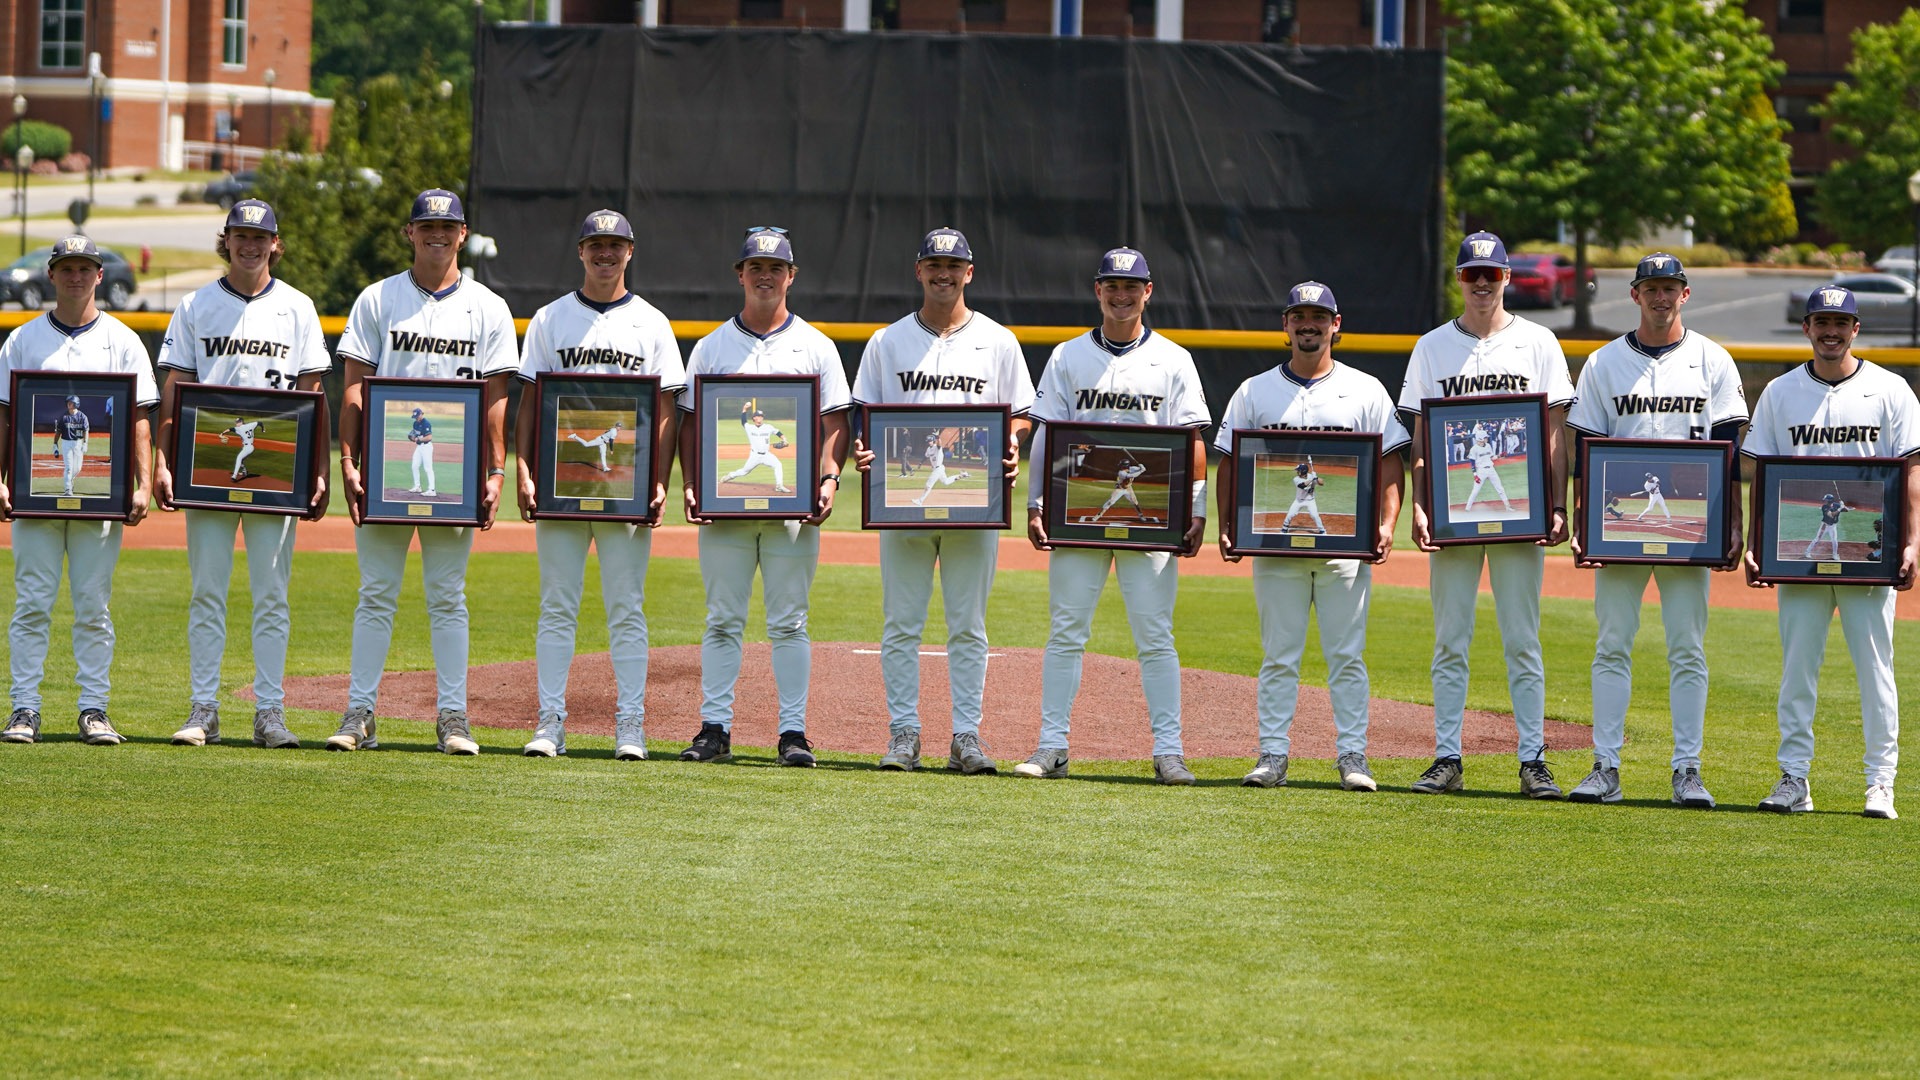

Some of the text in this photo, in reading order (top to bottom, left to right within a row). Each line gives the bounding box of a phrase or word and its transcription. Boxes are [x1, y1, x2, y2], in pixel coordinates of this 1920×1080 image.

[240, 205, 267, 223] W
[424, 196, 453, 214] W
[592, 214, 620, 233] W
[62, 237, 88, 252] W
[754, 235, 781, 253] W
[931, 234, 959, 252] W
[1469, 239, 1497, 258] W
[1110, 253, 1138, 271] W
[1296, 284, 1325, 302] W
[1819, 289, 1848, 307] W
[201, 336, 291, 359] WINGATE
[389, 329, 477, 357] WINGATE
[556, 346, 646, 371] WINGATE
[897, 371, 988, 395] WINGATE
[1436, 372, 1531, 398] WINGATE
[1075, 388, 1165, 412] WINGATE
[1613, 393, 1708, 416] WINGATE
[1788, 424, 1881, 446] WINGATE
